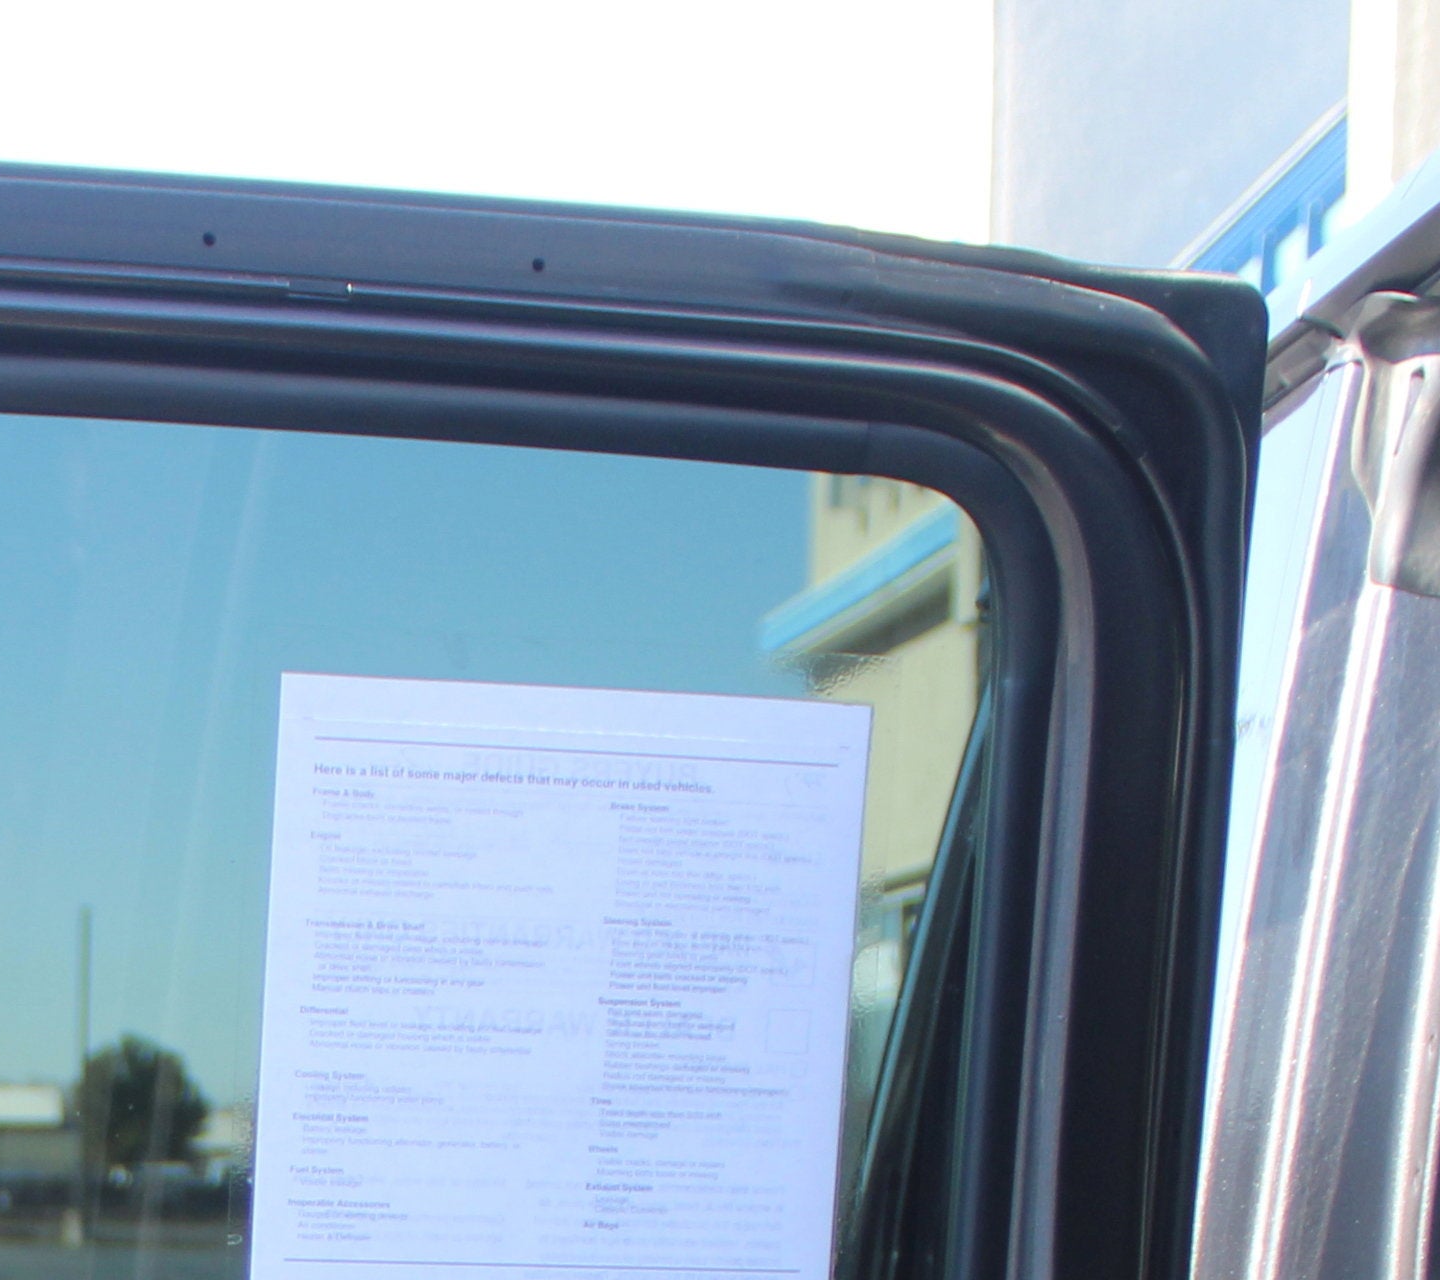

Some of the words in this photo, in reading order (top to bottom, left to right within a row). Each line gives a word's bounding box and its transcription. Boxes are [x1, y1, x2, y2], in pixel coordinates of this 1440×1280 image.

[314, 763, 342, 775] Here
[346, 765, 356, 776] is
[360, 768, 367, 777] a
[371, 766, 389, 778] list
[392, 767, 404, 778] of
[408, 770, 440, 780] some
[443, 772, 477, 785] major
[481, 771, 524, 784] defects
[528, 773, 550, 785] that
[554, 777, 578, 790] may
[582, 779, 614, 789] occur
[618, 778, 629, 789] in
[632, 778, 661, 791] used
[664, 780, 716, 794] vehicles.
[637, 803, 669, 812] System
[294, 1070, 329, 1081] Cooling
[332, 1071, 365, 1081] System
[292, 1113, 333, 1122] Electrical
[335, 1114, 368, 1122] System
[289, 1165, 309, 1174] Fuel
[311, 1166, 344, 1175] System
[622, 1184, 653, 1193] System
[288, 1198, 334, 1208] Inoperable
[337, 1200, 390, 1208] Accessories
